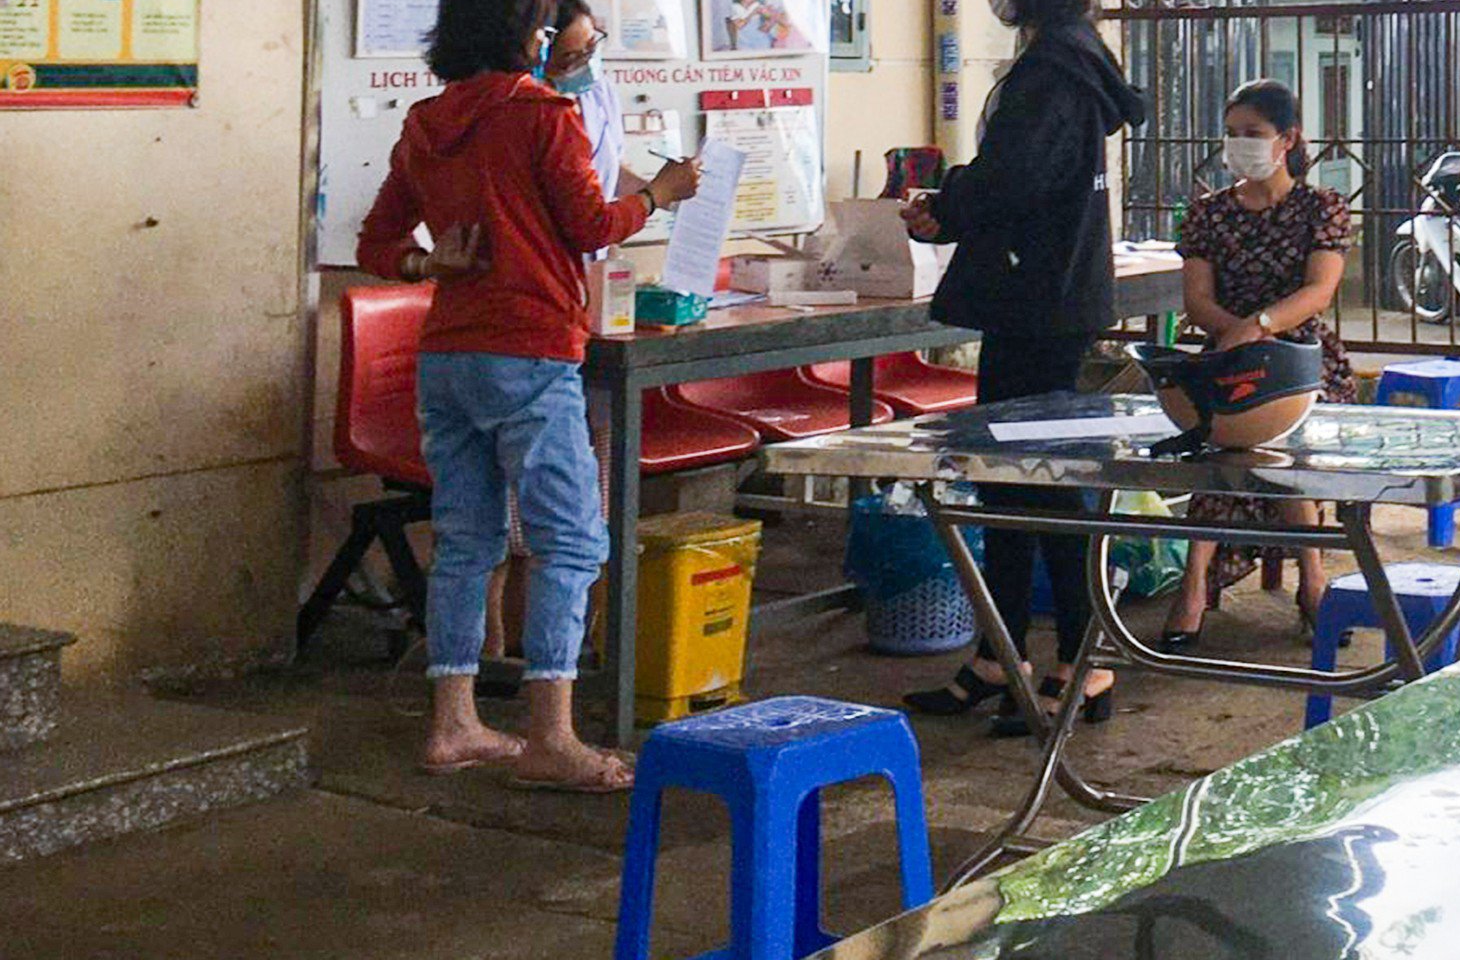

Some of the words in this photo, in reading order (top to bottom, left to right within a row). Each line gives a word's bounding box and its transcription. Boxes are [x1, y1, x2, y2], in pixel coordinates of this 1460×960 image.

[370, 72, 417, 91] LỊCH
[708, 66, 744, 82] TIÊM
[782, 68, 801, 81] XIN
